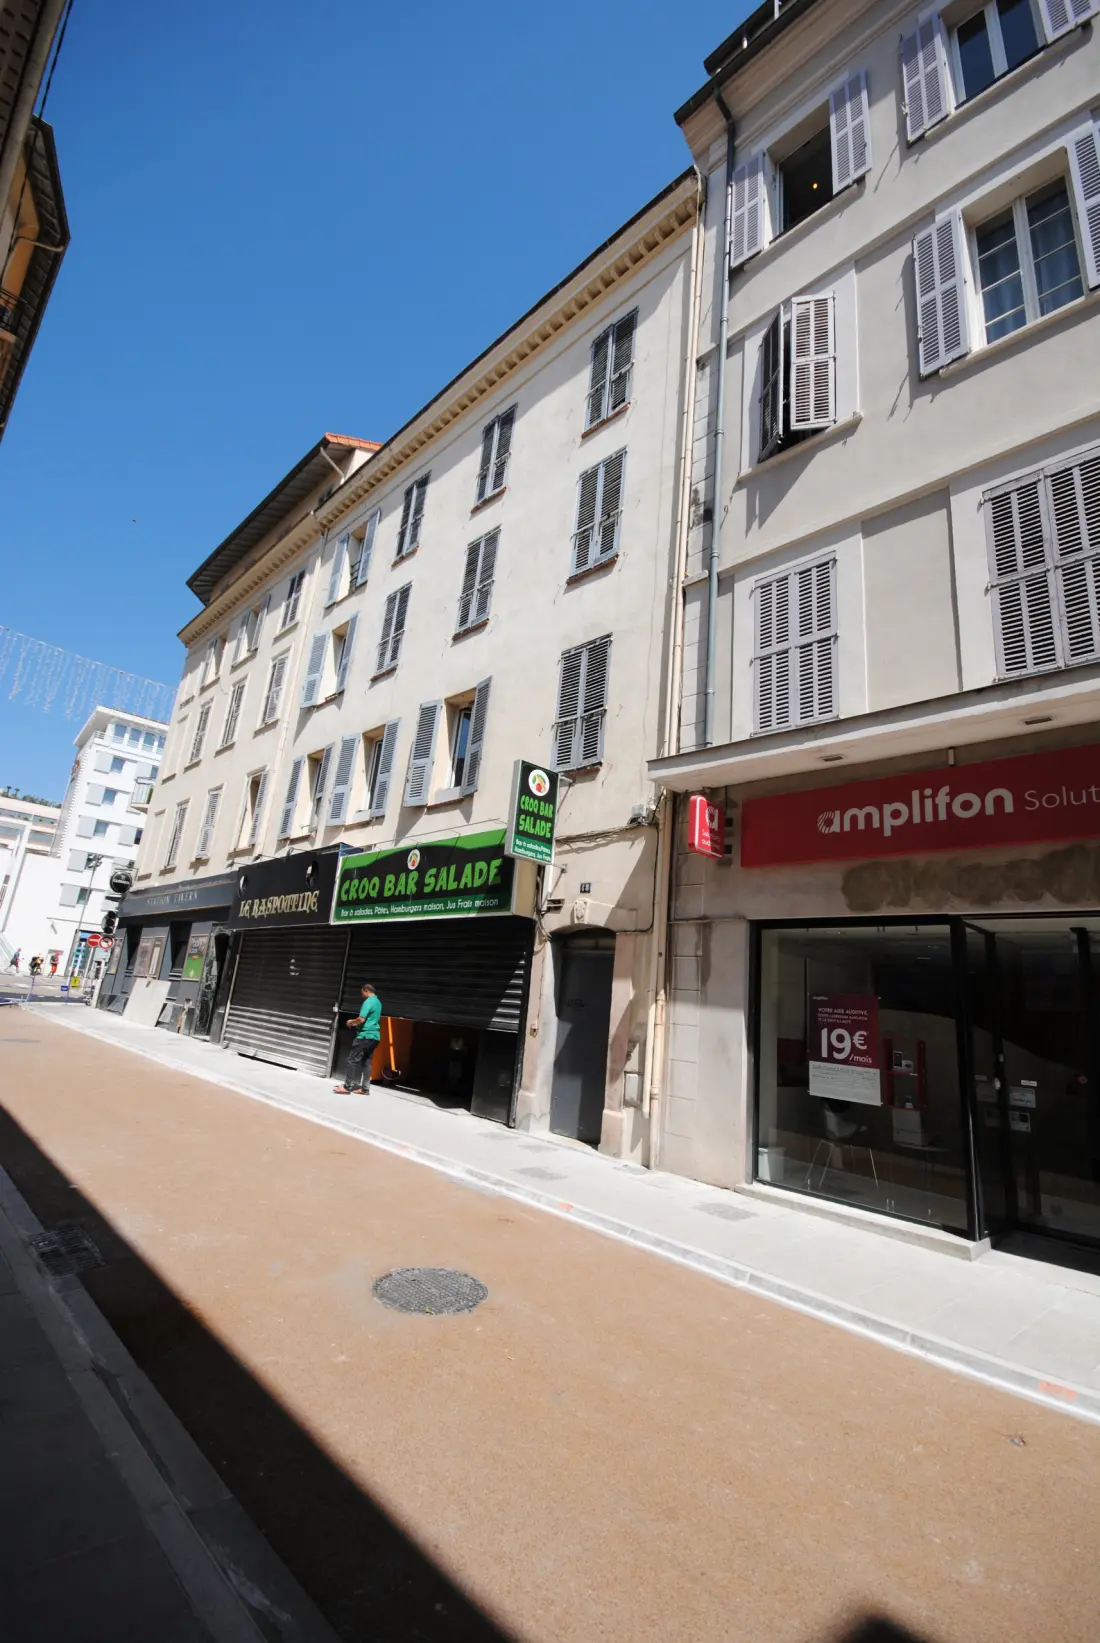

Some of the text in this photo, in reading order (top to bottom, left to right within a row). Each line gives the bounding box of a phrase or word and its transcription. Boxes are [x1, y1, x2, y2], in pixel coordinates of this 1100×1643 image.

[520, 794, 554, 818] CROQ BAR
[817, 784, 1100, 837] amplifon Solut
[518, 814, 552, 838] SALADE
[340, 858, 503, 902] CROQ BAR SALADE
[238, 899, 251, 919] LE
[391, 903, 422, 914] Hamburgers
[423, 903, 445, 911] maison,
[446, 900, 456, 909] Jus
[457, 899, 473, 909] Frais
[474, 898, 499, 908] maison
[849, 1054, 873, 1064] /mois
